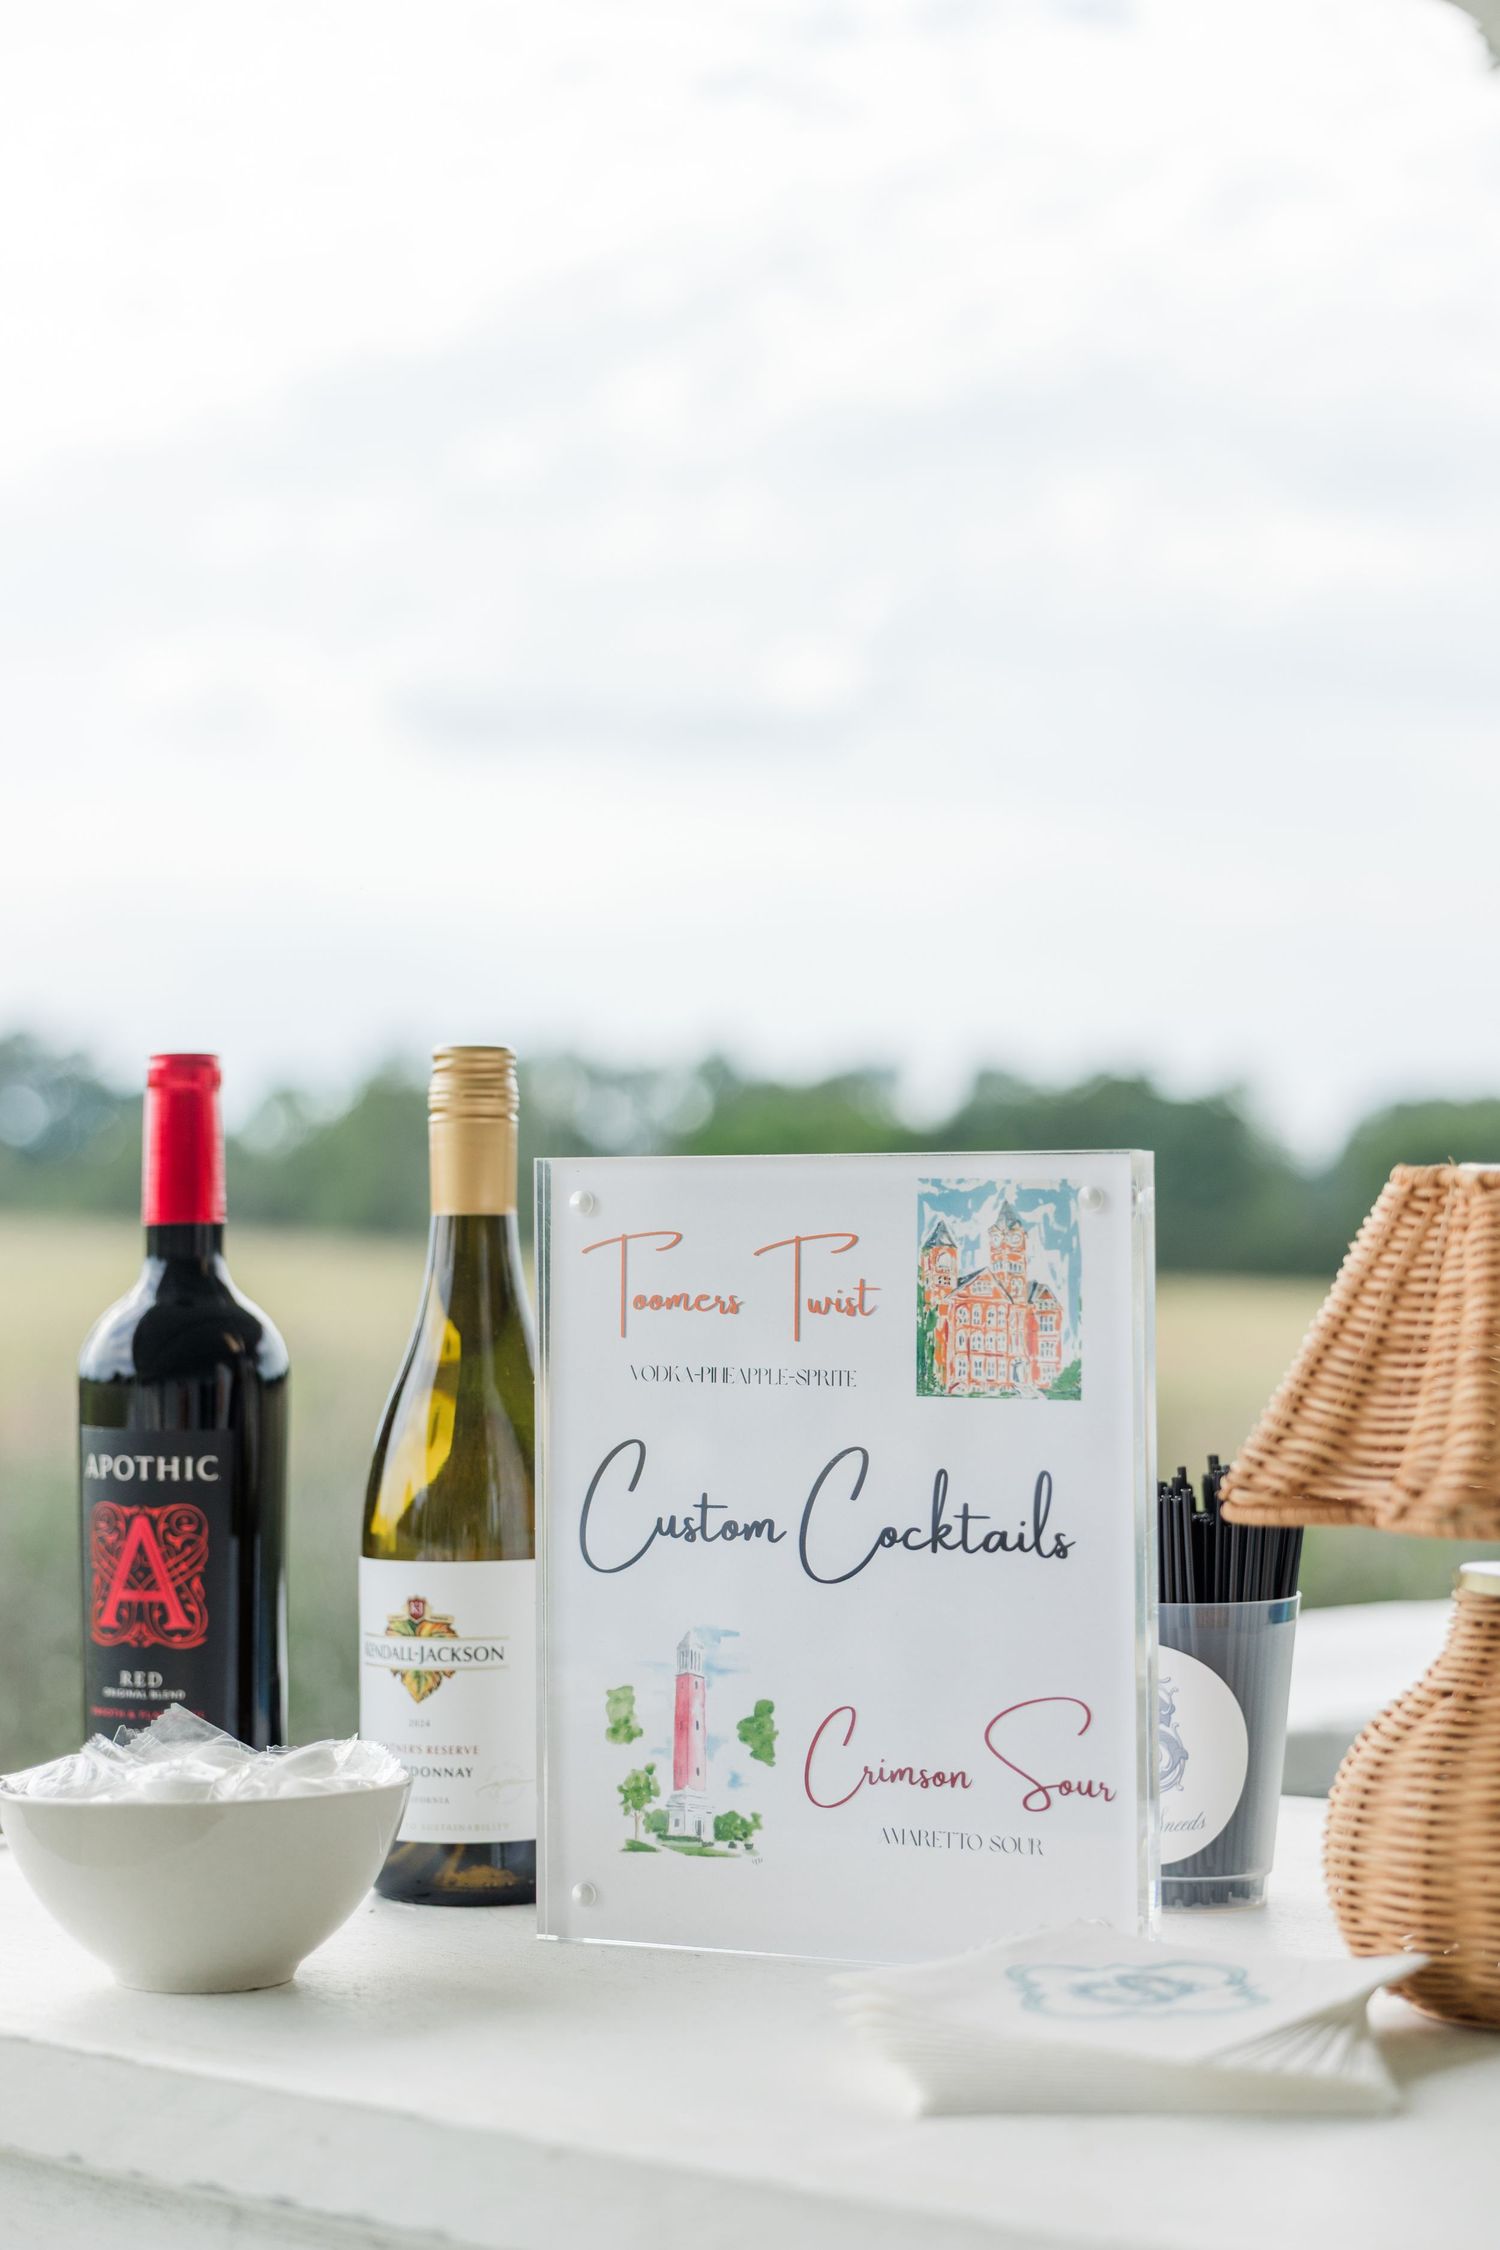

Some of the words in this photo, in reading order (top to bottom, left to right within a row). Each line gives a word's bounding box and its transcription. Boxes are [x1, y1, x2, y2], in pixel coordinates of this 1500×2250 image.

[582, 1231, 744, 1338] Toomers
[753, 1233, 882, 1342] Twist
[84, 1453, 219, 1482] APOTHIC
[579, 1438, 787, 1573] Custom
[799, 1446, 1076, 1584] Cocktails
[99, 1514, 194, 1629] A
[119, 1670, 163, 1688] RED
[150, 1689, 186, 1700] BLEND
[426, 1745, 480, 1755] RESERVE
[804, 1705, 972, 1808] Crimson
[984, 1697, 1117, 1812] Sour
[403, 1765, 473, 1778] DONNAY
[880, 1827, 983, 1850] AMARETTO
[989, 1835, 1043, 1856] SOUR
